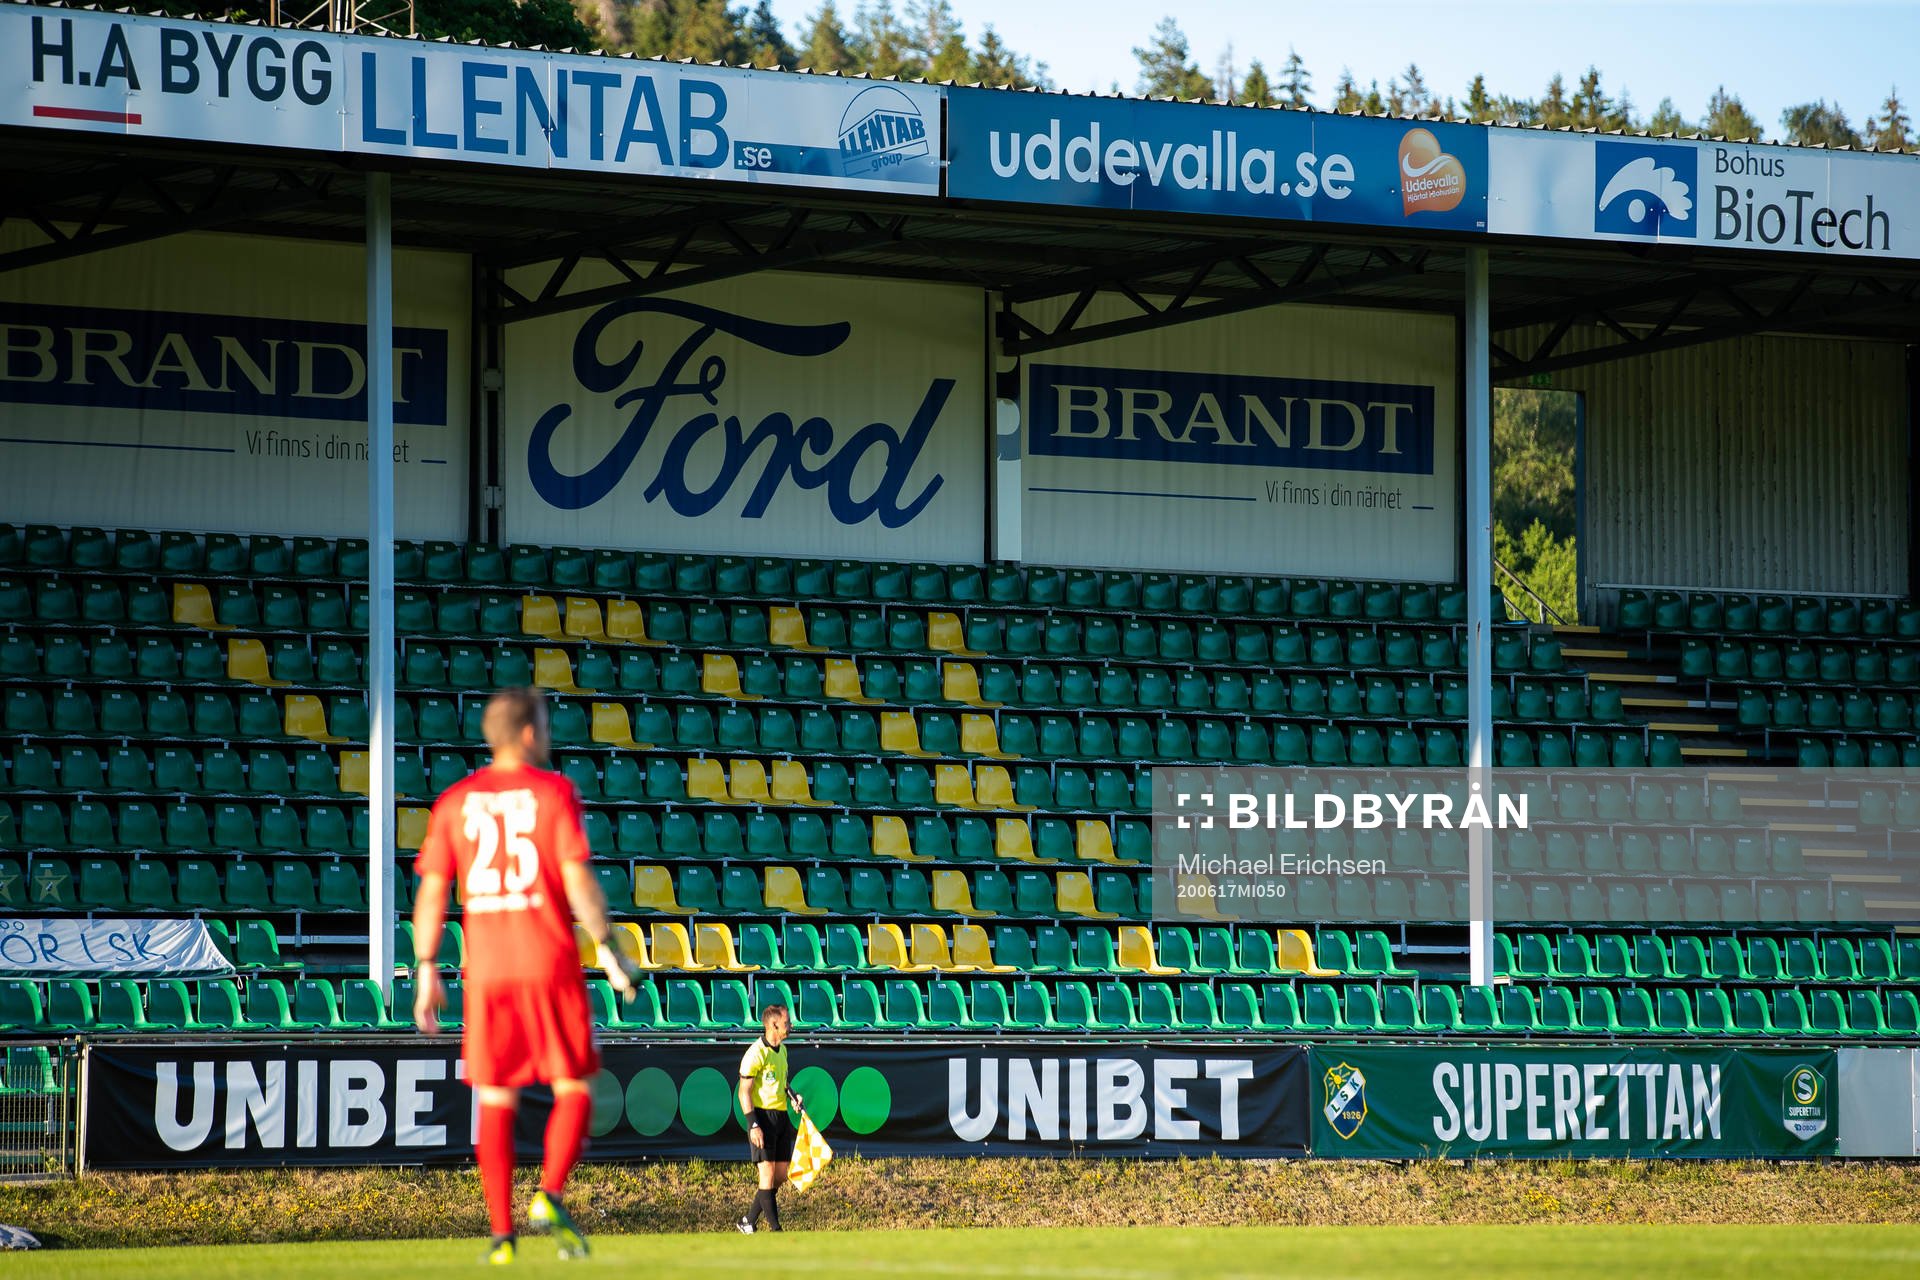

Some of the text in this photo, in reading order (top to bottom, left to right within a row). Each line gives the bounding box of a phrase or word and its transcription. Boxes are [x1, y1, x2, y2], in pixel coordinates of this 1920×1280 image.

[31, 16, 331, 105] H.A BYGG
[839, 114, 925, 158] LLENTAB
[871, 153, 903, 172] group
[990, 119, 1355, 199] uddevalla.se
[1715, 146, 1784, 178] Bohus
[1406, 176, 1458, 192] Uddevalla
[1714, 185, 1890, 250] BioTech
[528, 297, 956, 528] Ford
[1050, 384, 1413, 454] BRANDT
[246, 430, 261, 455] Vi
[266, 431, 310, 458] finns
[325, 434, 350, 460] din
[1266, 480, 1279, 503] Vi
[1283, 481, 1320, 505] finns
[1331, 483, 1352, 506] din
[1357, 485, 1402, 510] närhet
[463, 801, 539, 893] 25
[948, 1058, 1254, 1142] UNIBET
[1331, 1078, 1360, 1114] LSK
[1342, 1111, 1361, 1120] 1926
[1432, 1062, 1721, 1141] SUPERETTAN
